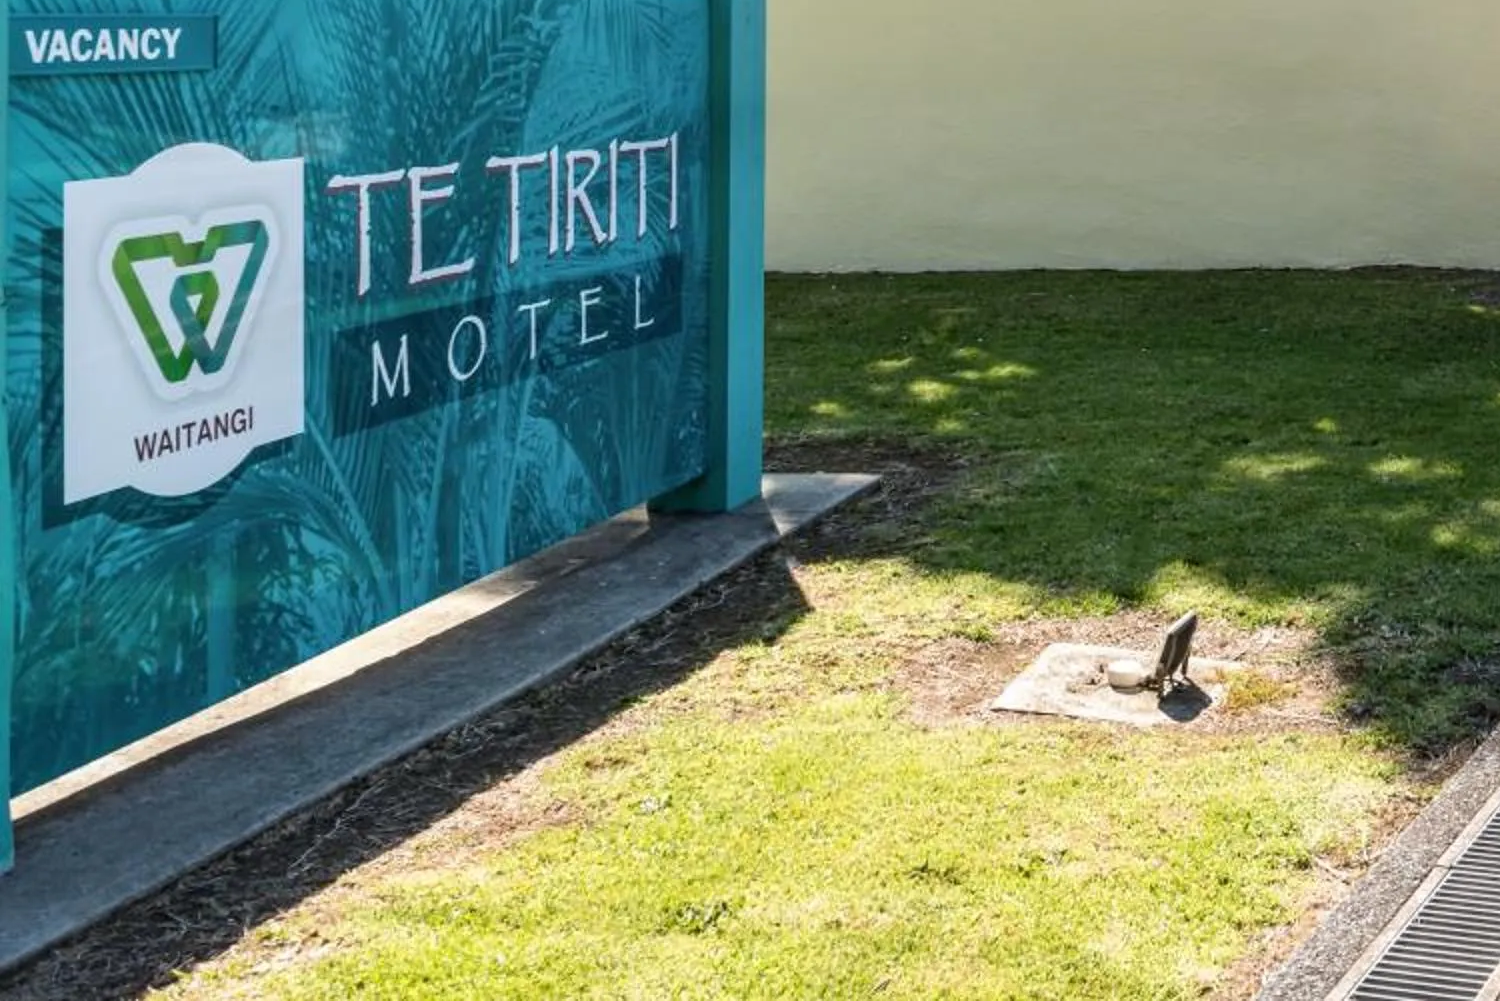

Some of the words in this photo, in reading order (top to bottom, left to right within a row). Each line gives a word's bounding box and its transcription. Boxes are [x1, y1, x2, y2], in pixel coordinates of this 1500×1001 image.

[25, 27, 182, 64] VACANCY
[326, 162, 476, 296] TE
[485, 131, 679, 265] TIRITI
[370, 274, 656, 407] MOTEL
[133, 404, 254, 463] WAITANGI
